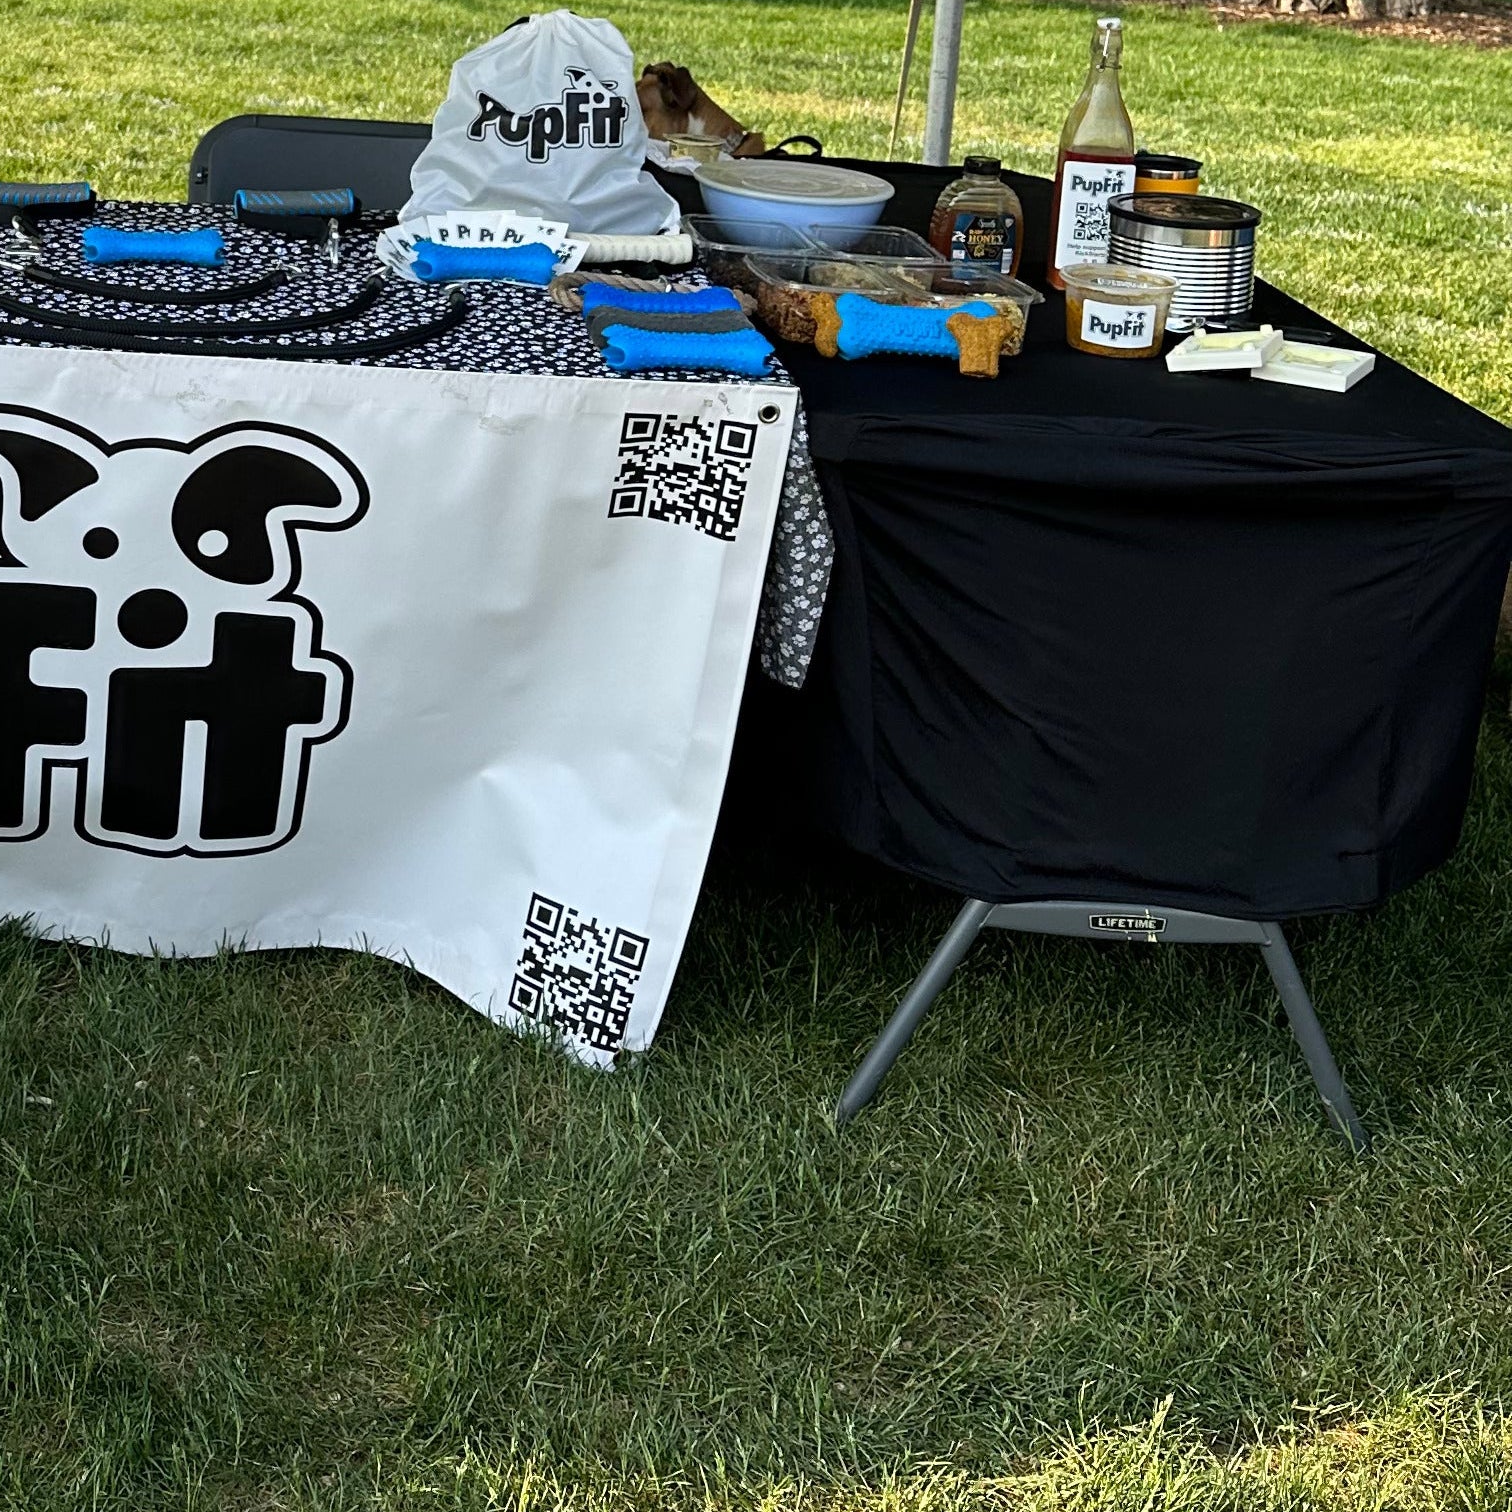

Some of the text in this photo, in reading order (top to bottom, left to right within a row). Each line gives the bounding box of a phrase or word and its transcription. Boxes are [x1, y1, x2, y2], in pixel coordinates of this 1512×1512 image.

[468, 91, 628, 161] PupFit
[1071, 175, 1124, 197] PupFit
[1089, 315, 1145, 340] PupFit
[1098, 917, 1157, 929] LIFETIME
